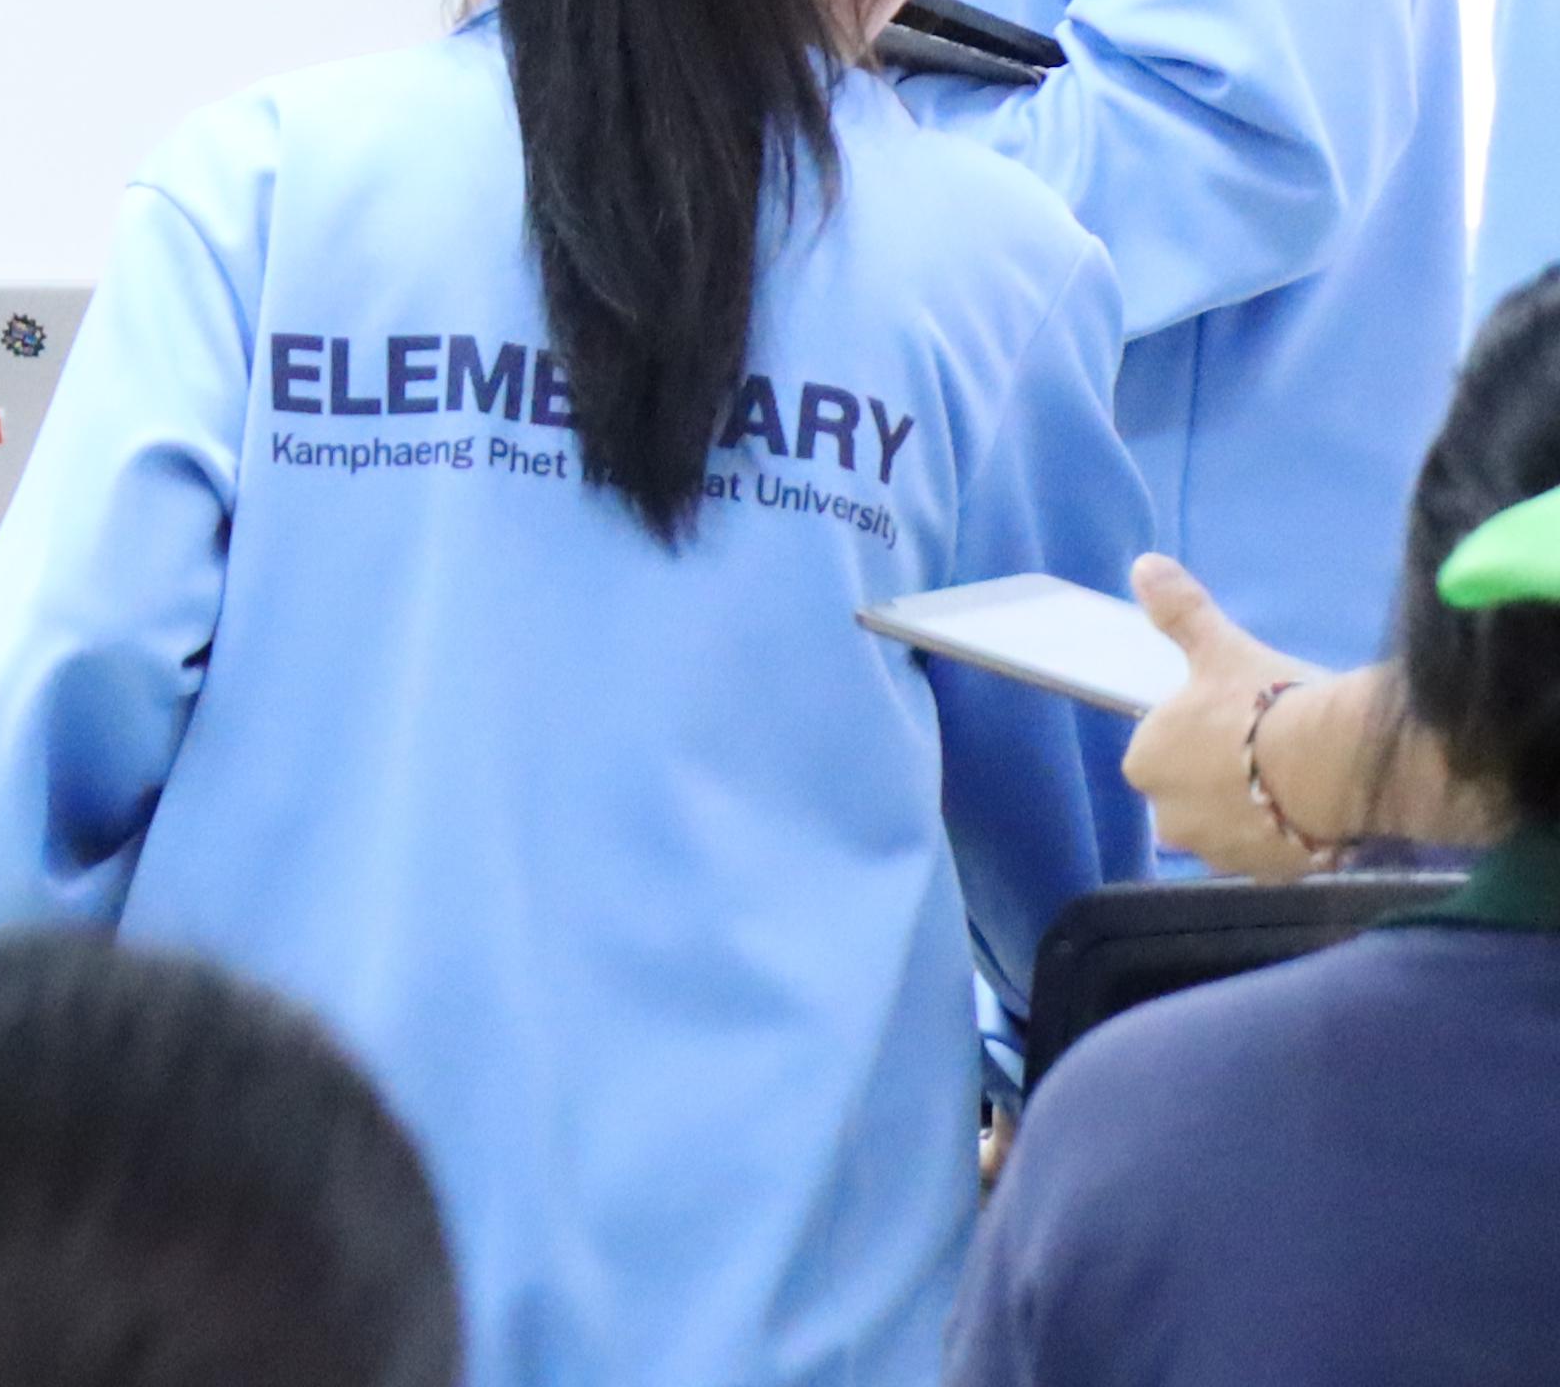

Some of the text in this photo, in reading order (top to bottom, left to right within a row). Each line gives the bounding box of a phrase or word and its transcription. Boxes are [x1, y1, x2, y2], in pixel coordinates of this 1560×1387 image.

[270, 332, 916, 486] ELEMEARY
[273, 432, 475, 474] Kamphaeng
[488, 437, 569, 478] Phet
